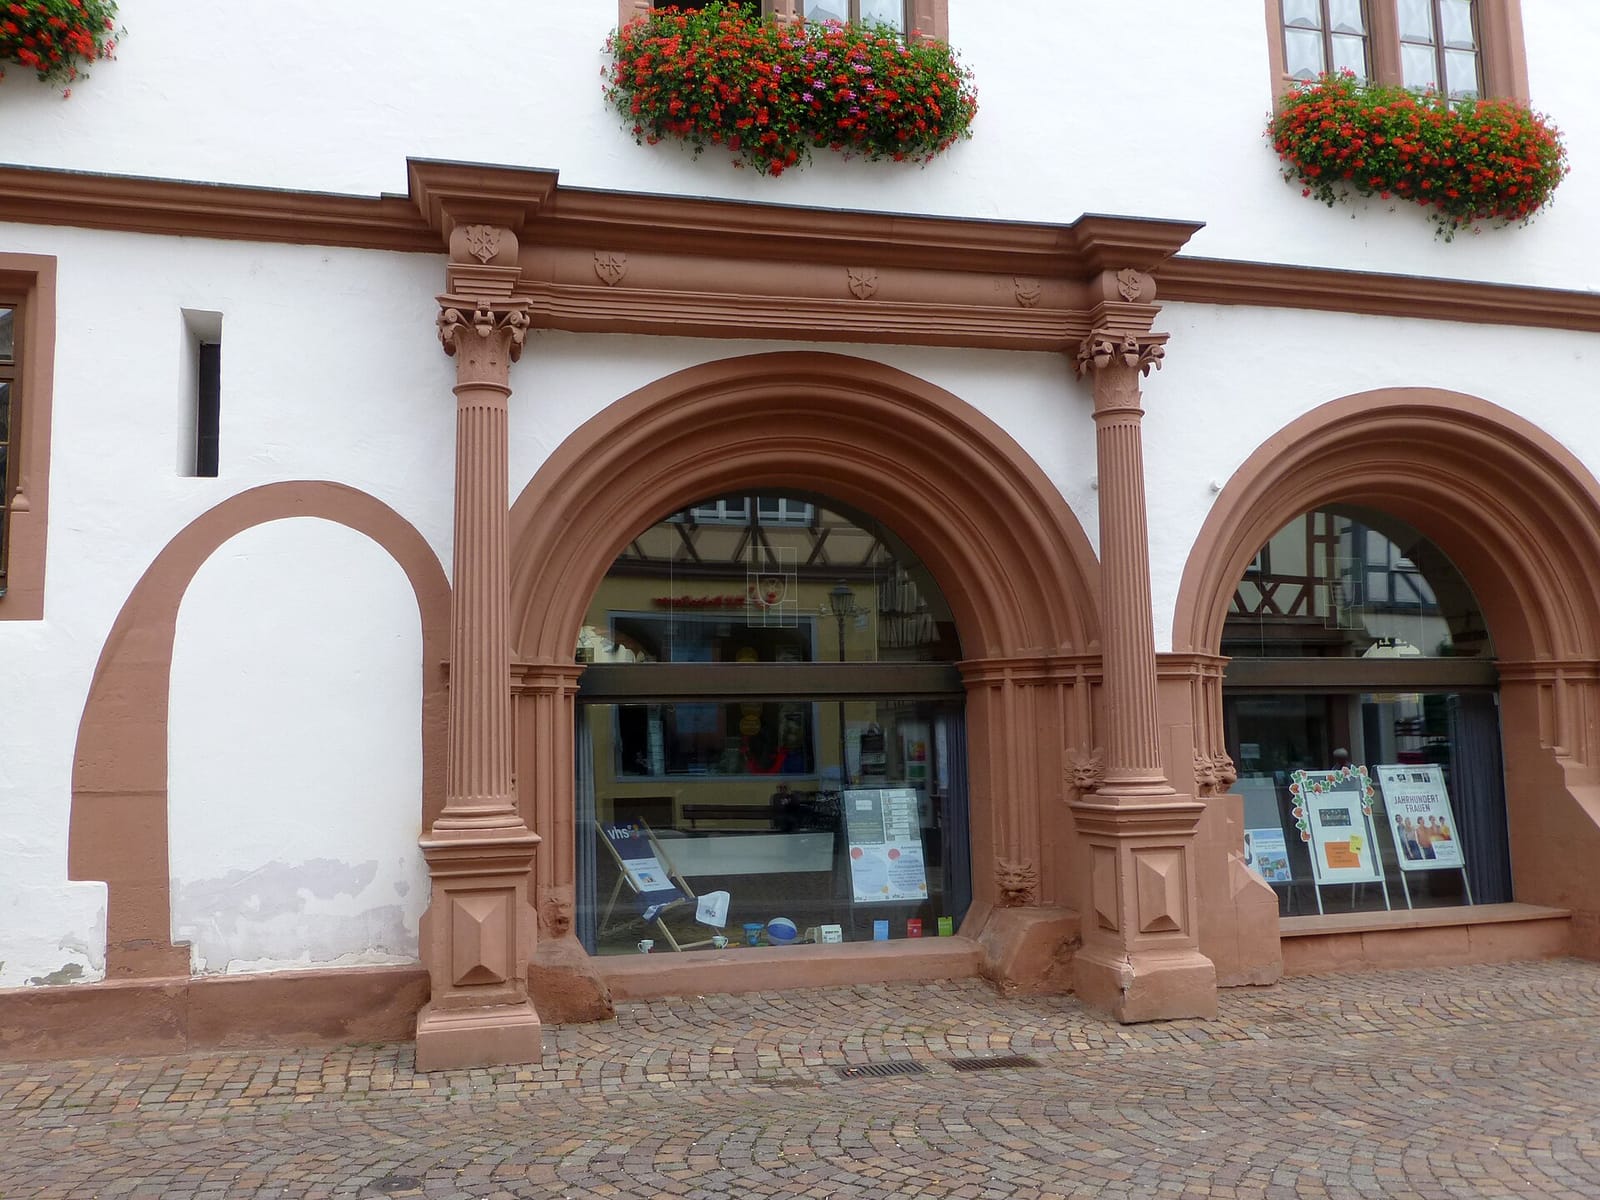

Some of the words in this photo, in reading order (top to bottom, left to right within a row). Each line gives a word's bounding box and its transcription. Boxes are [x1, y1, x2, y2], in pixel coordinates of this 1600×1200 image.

[1394, 794, 1439, 804] JAHRHUNDERT
[1405, 804, 1431, 813] FRAUEN
[607, 826, 630, 839] vhs
